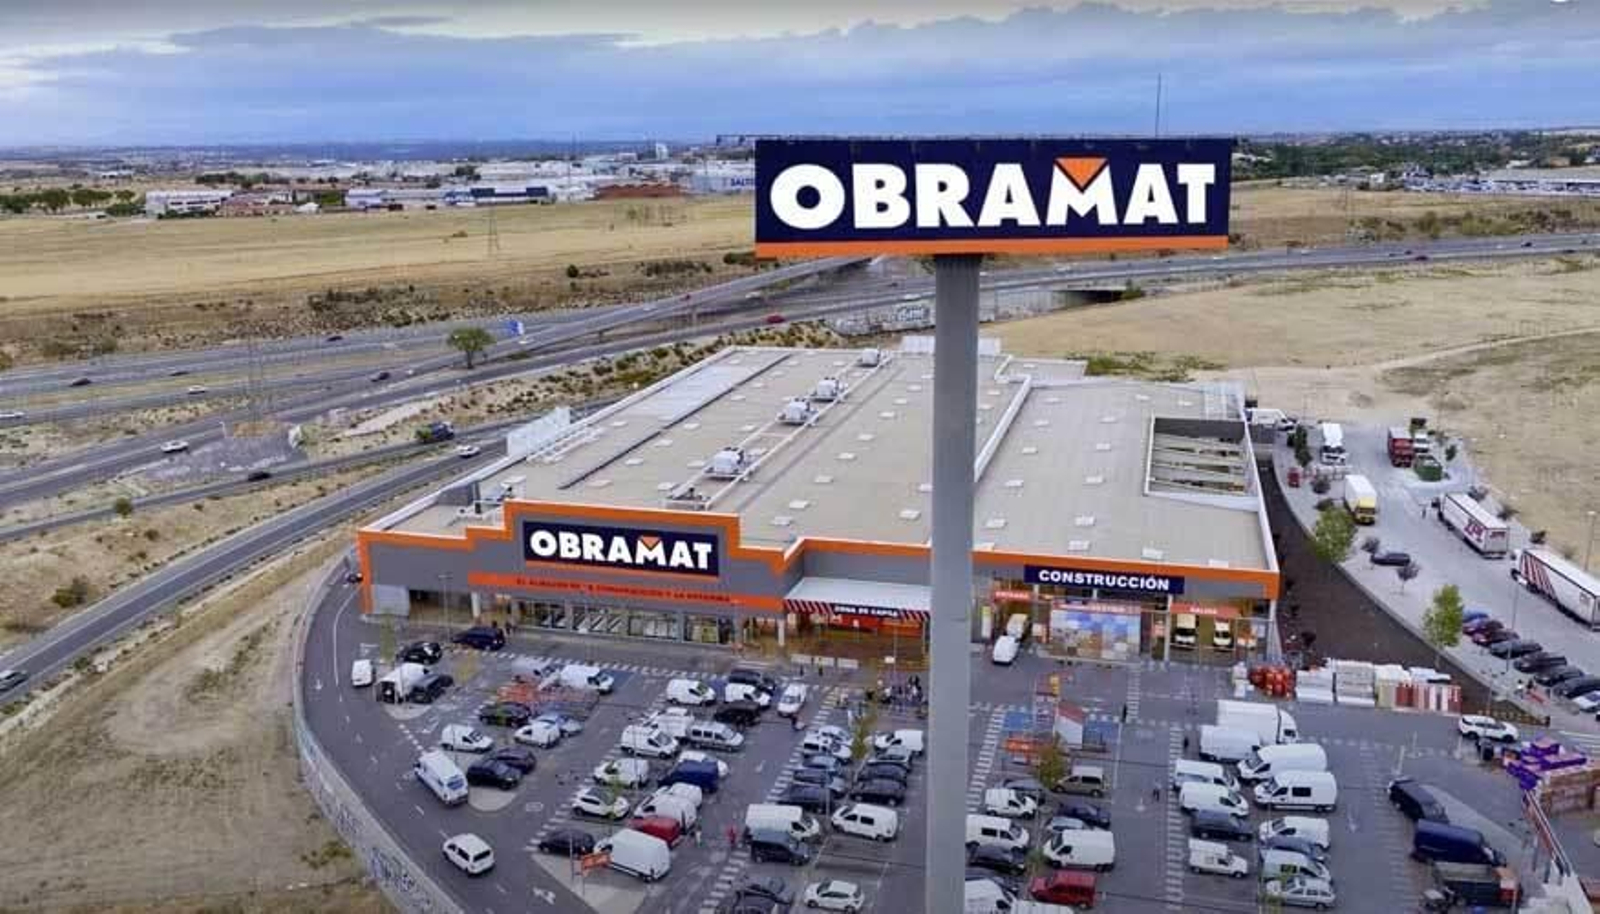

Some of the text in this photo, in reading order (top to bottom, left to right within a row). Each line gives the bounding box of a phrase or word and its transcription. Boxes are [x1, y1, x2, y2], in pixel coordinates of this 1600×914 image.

[769, 157, 1216, 231] OBRAMAT
[528, 529, 713, 570] OBRAMAT
[1038, 569, 1170, 592] CONSTRUCCIÓN
